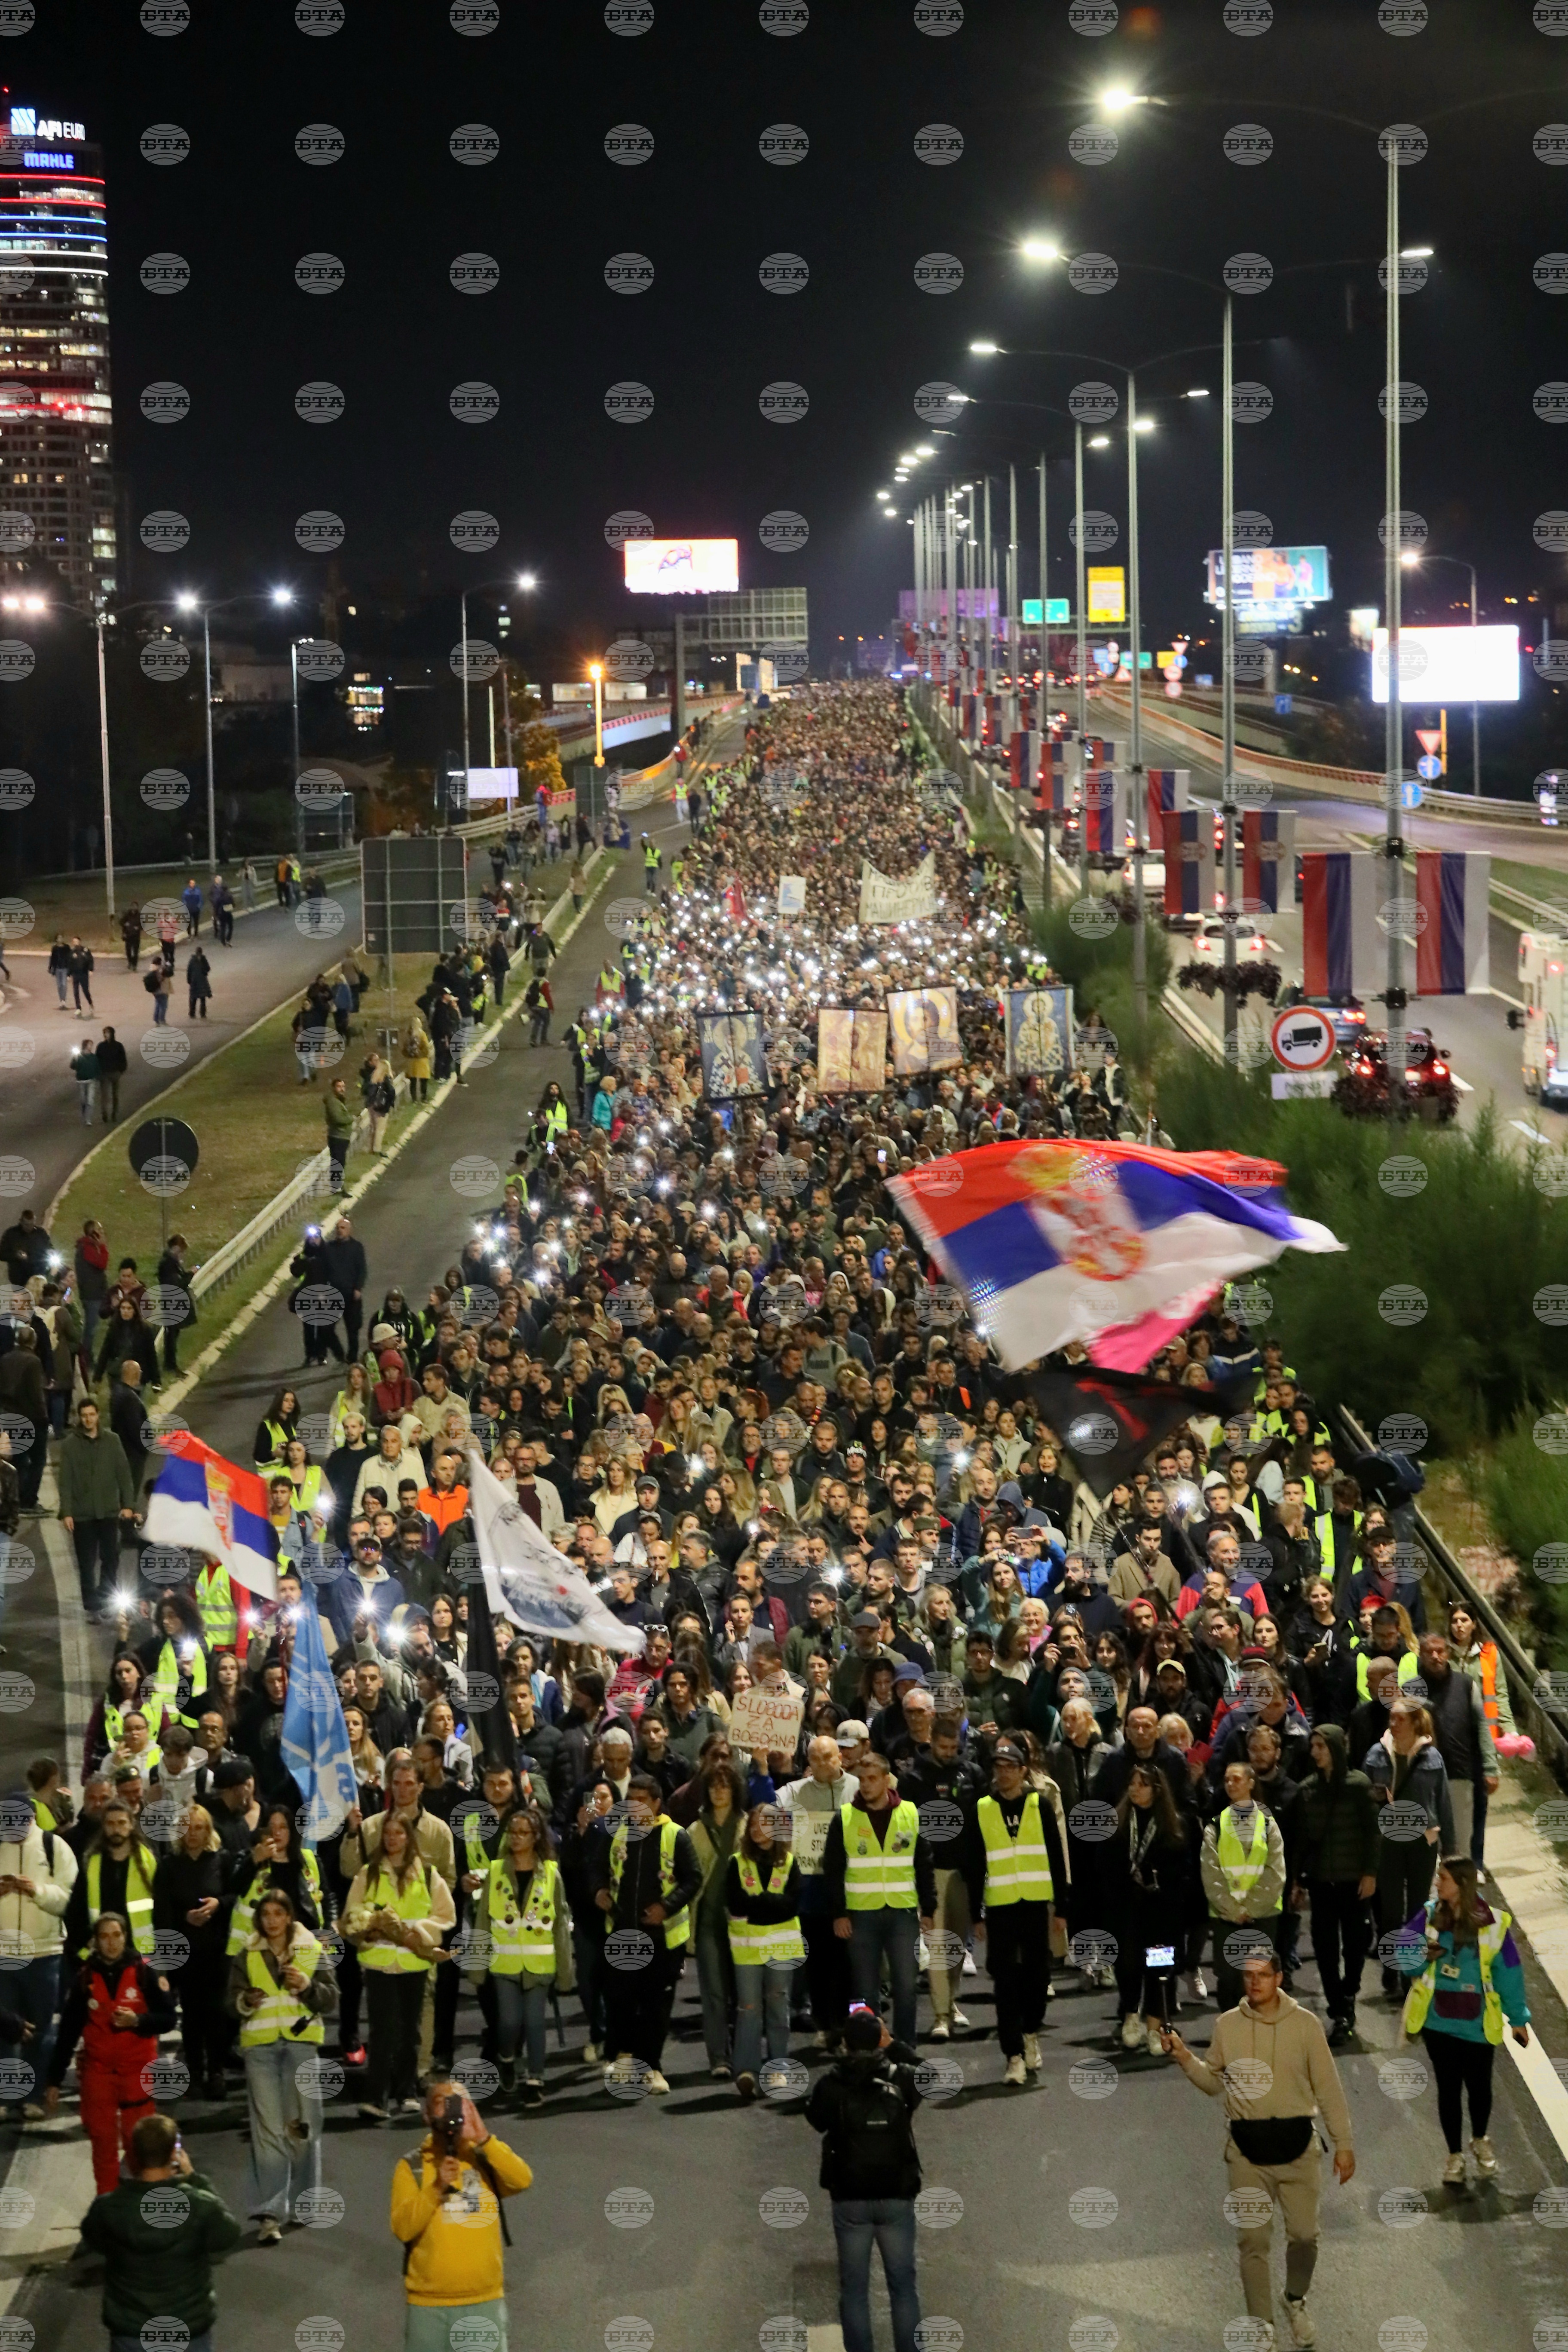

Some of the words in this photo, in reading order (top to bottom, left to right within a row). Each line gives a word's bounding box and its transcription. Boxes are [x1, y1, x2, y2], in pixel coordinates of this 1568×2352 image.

[37, 120, 62, 138] AFI
[24, 153, 74, 169] MAHLE
[736, 1696, 799, 1721] SLOBODA
[746, 1715, 773, 1730] ZA
[732, 1728, 796, 1748] BOGDANA
